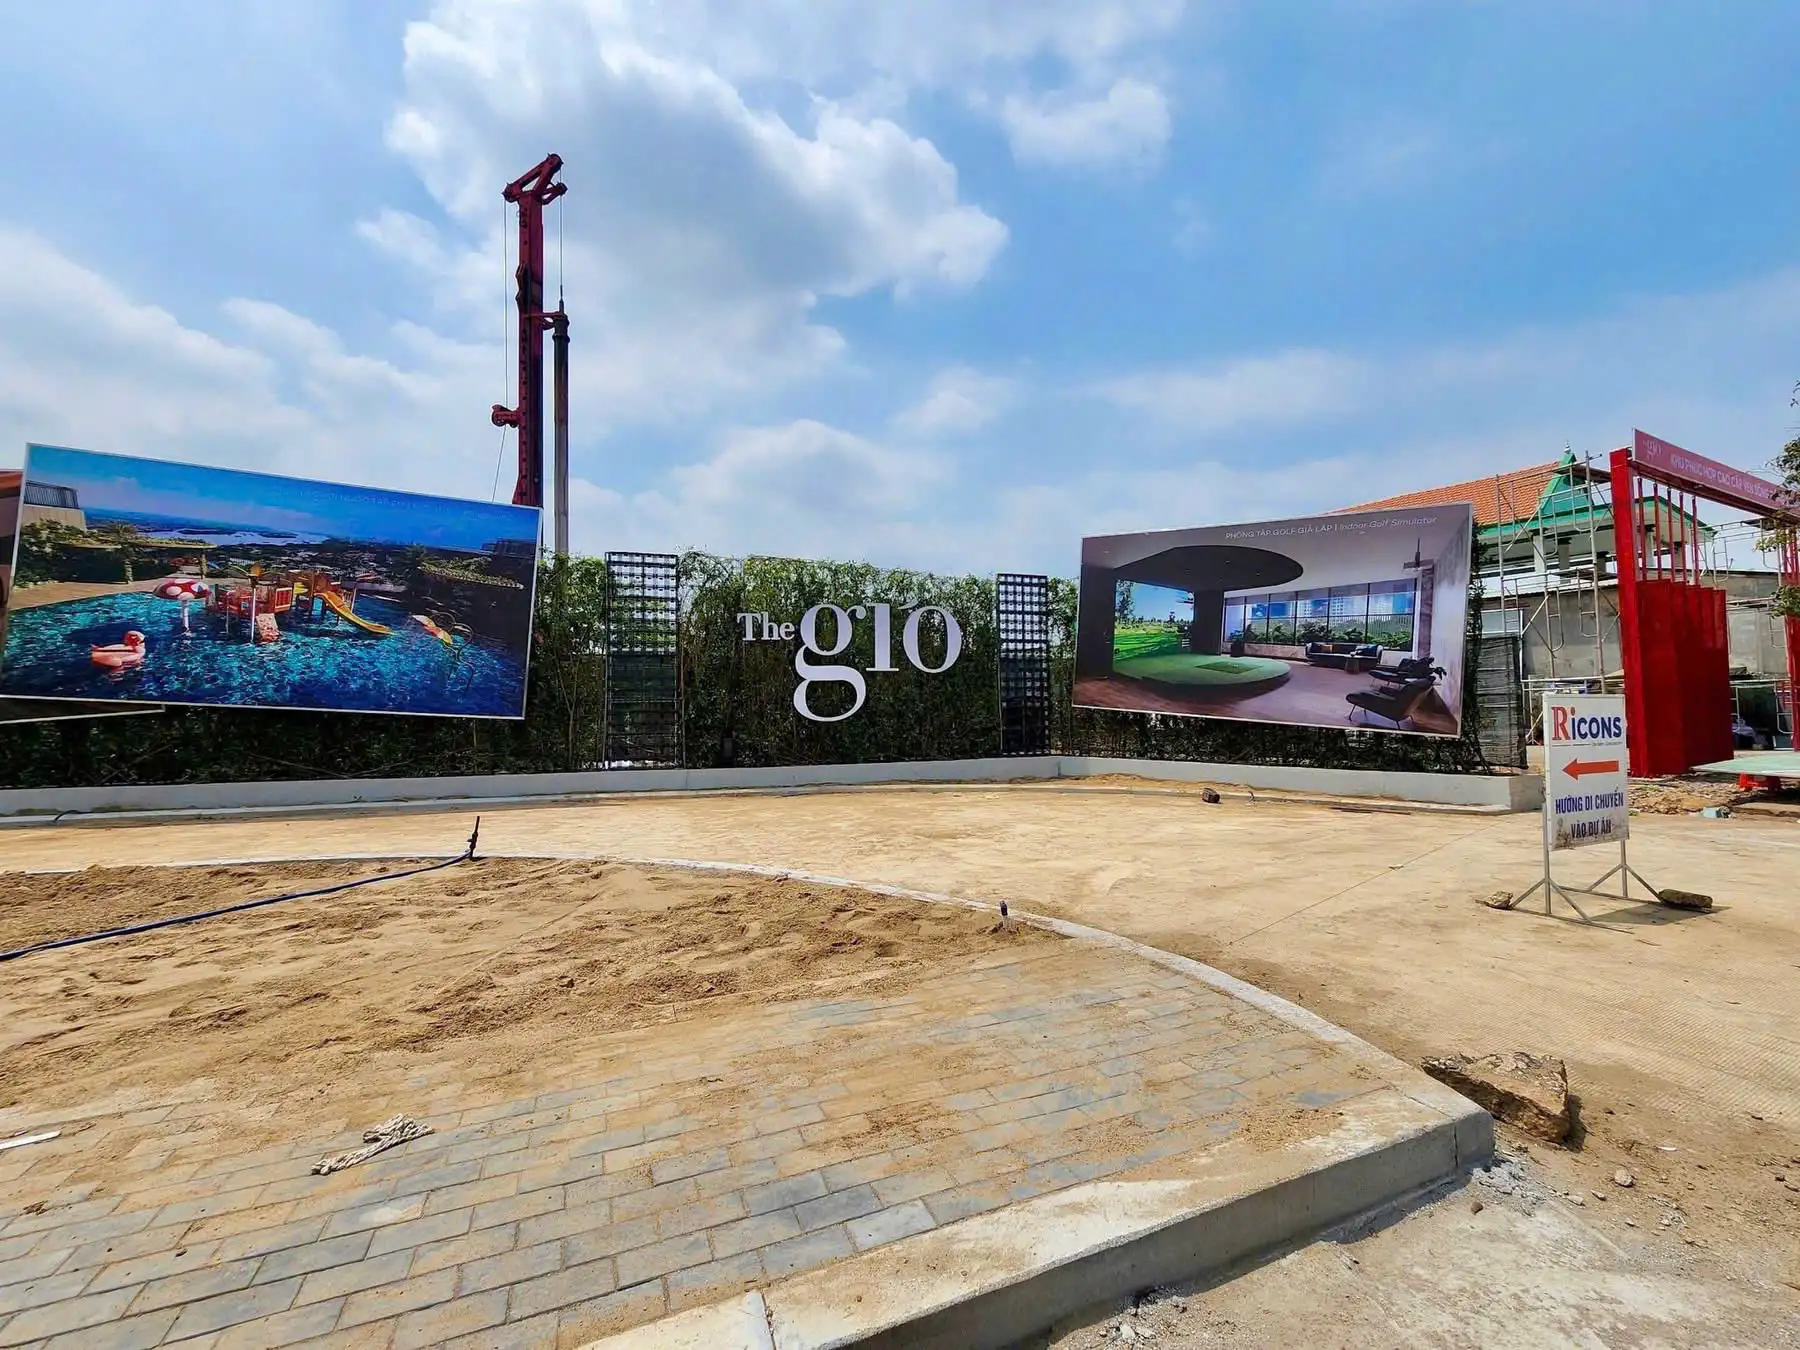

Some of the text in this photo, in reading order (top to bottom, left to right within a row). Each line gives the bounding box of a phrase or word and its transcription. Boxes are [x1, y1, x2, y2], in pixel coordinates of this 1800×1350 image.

[1272, 526, 1296, 536] GOLF
[1340, 522, 1367, 531] Indoor
[1369, 519, 1389, 528] Golf
[1390, 516, 1438, 527] Simulator
[736, 611, 796, 642] The
[1585, 795, 1594, 811] DI
[1595, 787, 1624, 810] CHUYỂN
